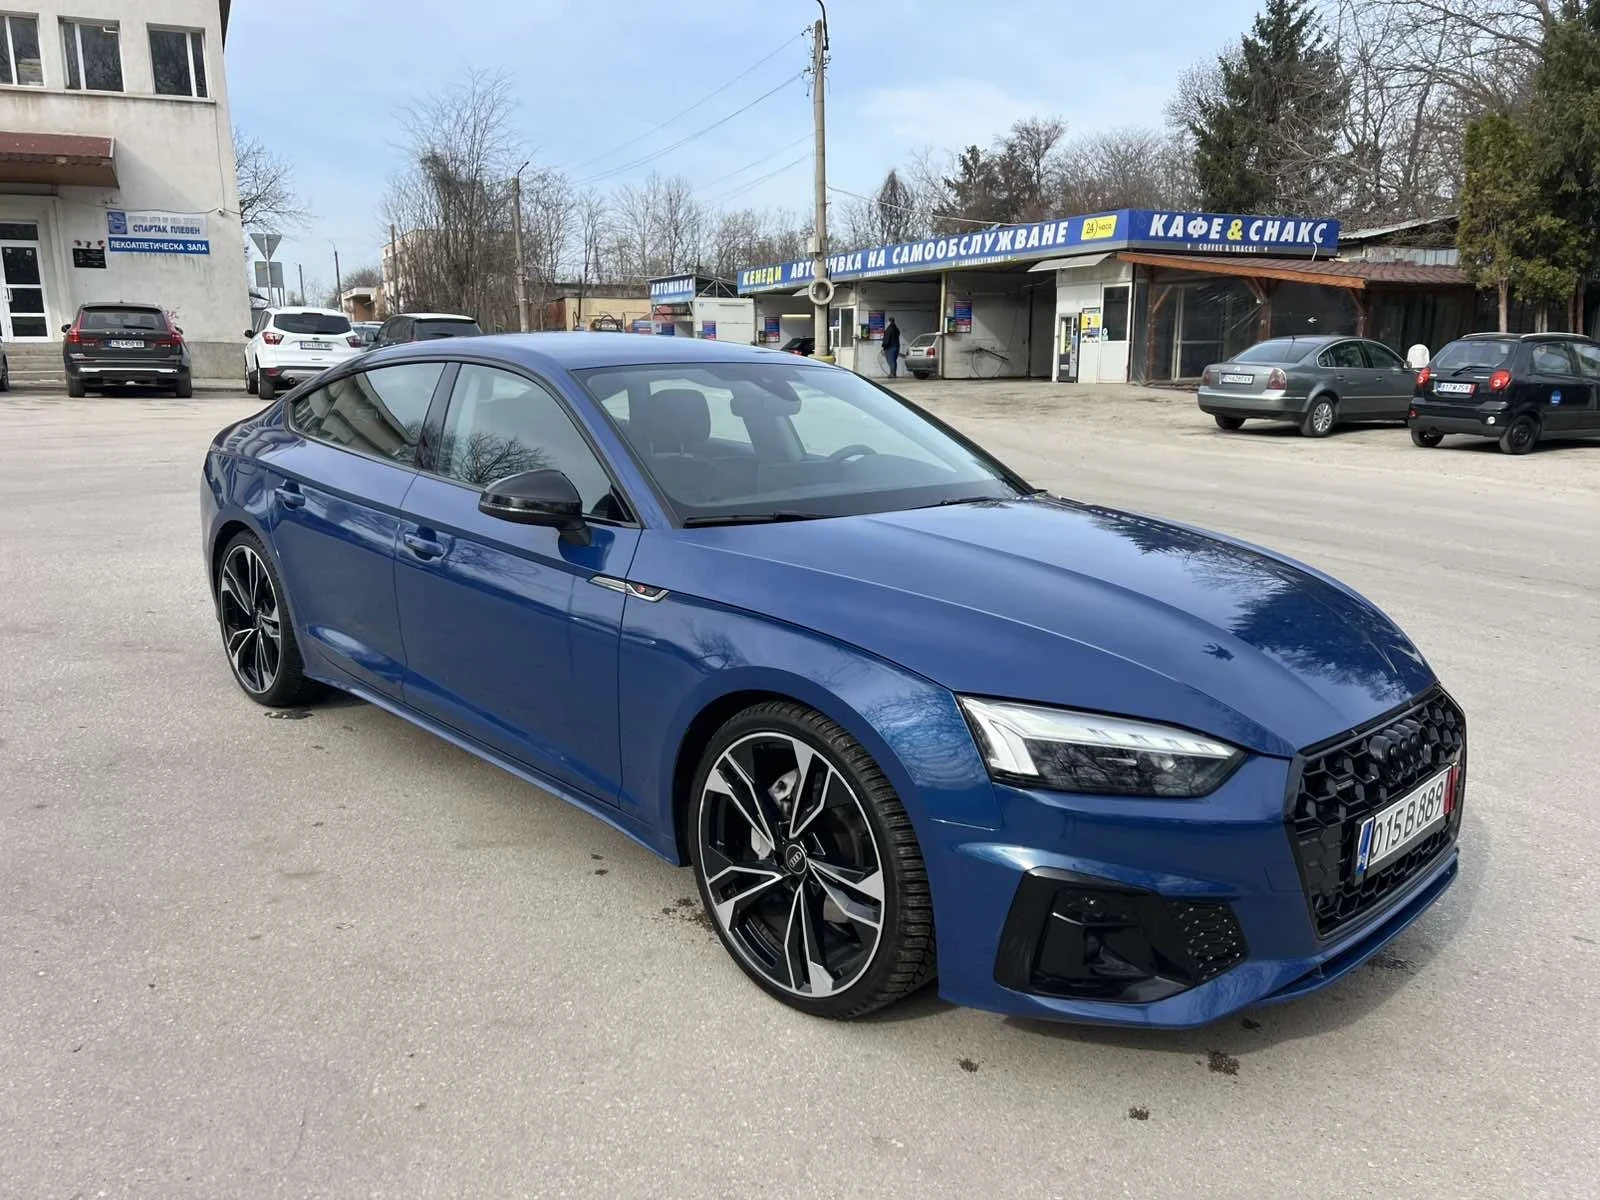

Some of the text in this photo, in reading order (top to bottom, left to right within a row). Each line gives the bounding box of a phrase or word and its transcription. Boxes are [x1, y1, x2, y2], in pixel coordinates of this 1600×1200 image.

[132, 224, 201, 234] СПАРТАК ПЛЕВЕН
[1150, 214, 1328, 243] КАФЕ & СНАКС
[110, 240, 207, 251] ЛЕКОАТЛЕТИЧЕСКА ЗАЛА
[742, 265, 782, 286] КЕНЕДИ
[867, 249, 886, 268] НА
[892, 221, 1069, 265] САМООБСЛУЖВАНЕ
[651, 278, 693, 296] АВТОМИВКА
